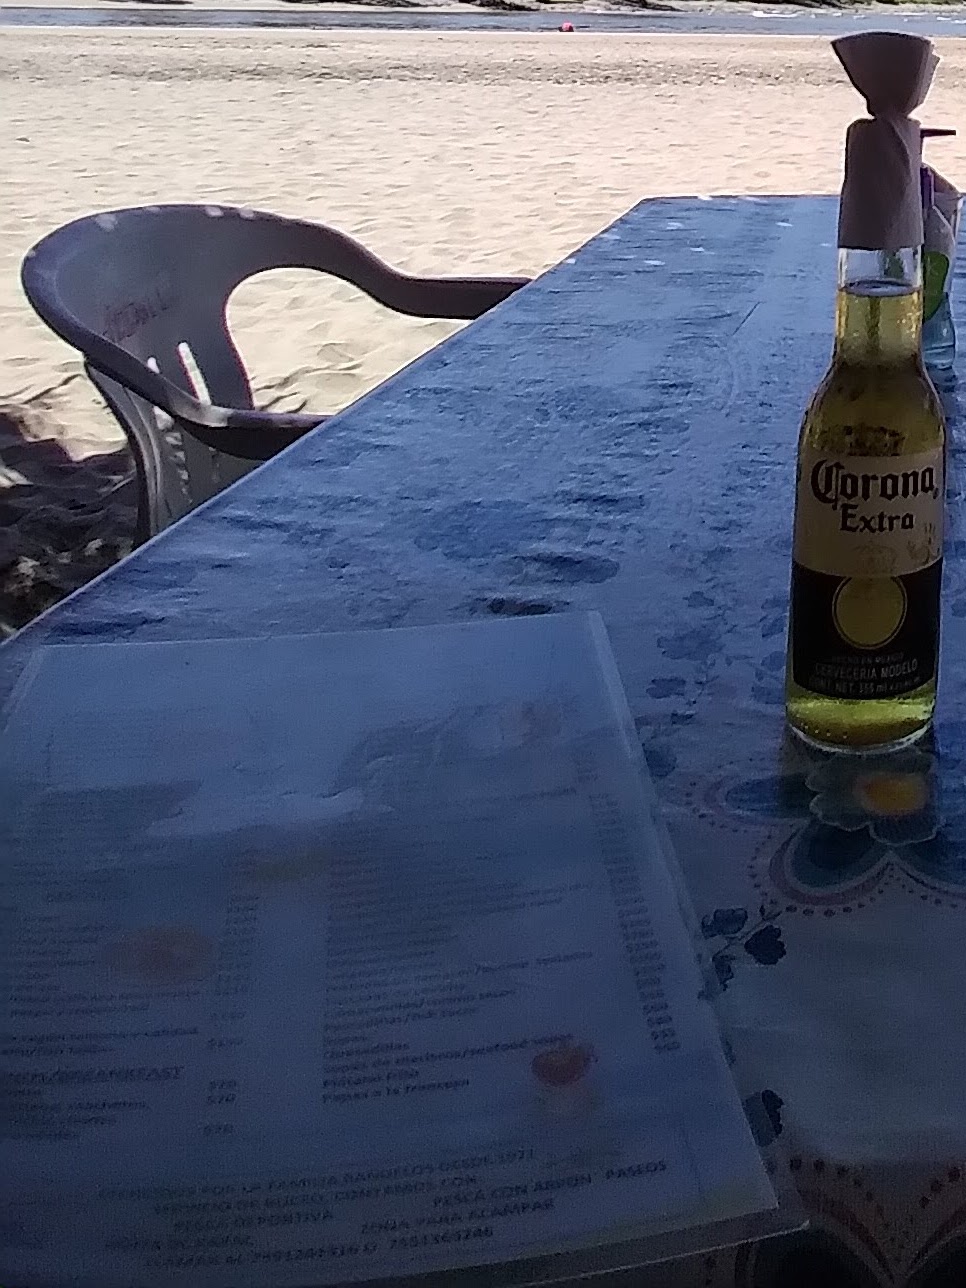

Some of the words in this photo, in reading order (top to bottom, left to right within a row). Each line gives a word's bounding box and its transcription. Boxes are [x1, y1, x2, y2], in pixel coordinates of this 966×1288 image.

[811, 459, 937, 511] Corona
[840, 502, 914, 534] Extra
[880, 658, 919, 679] MODELO
